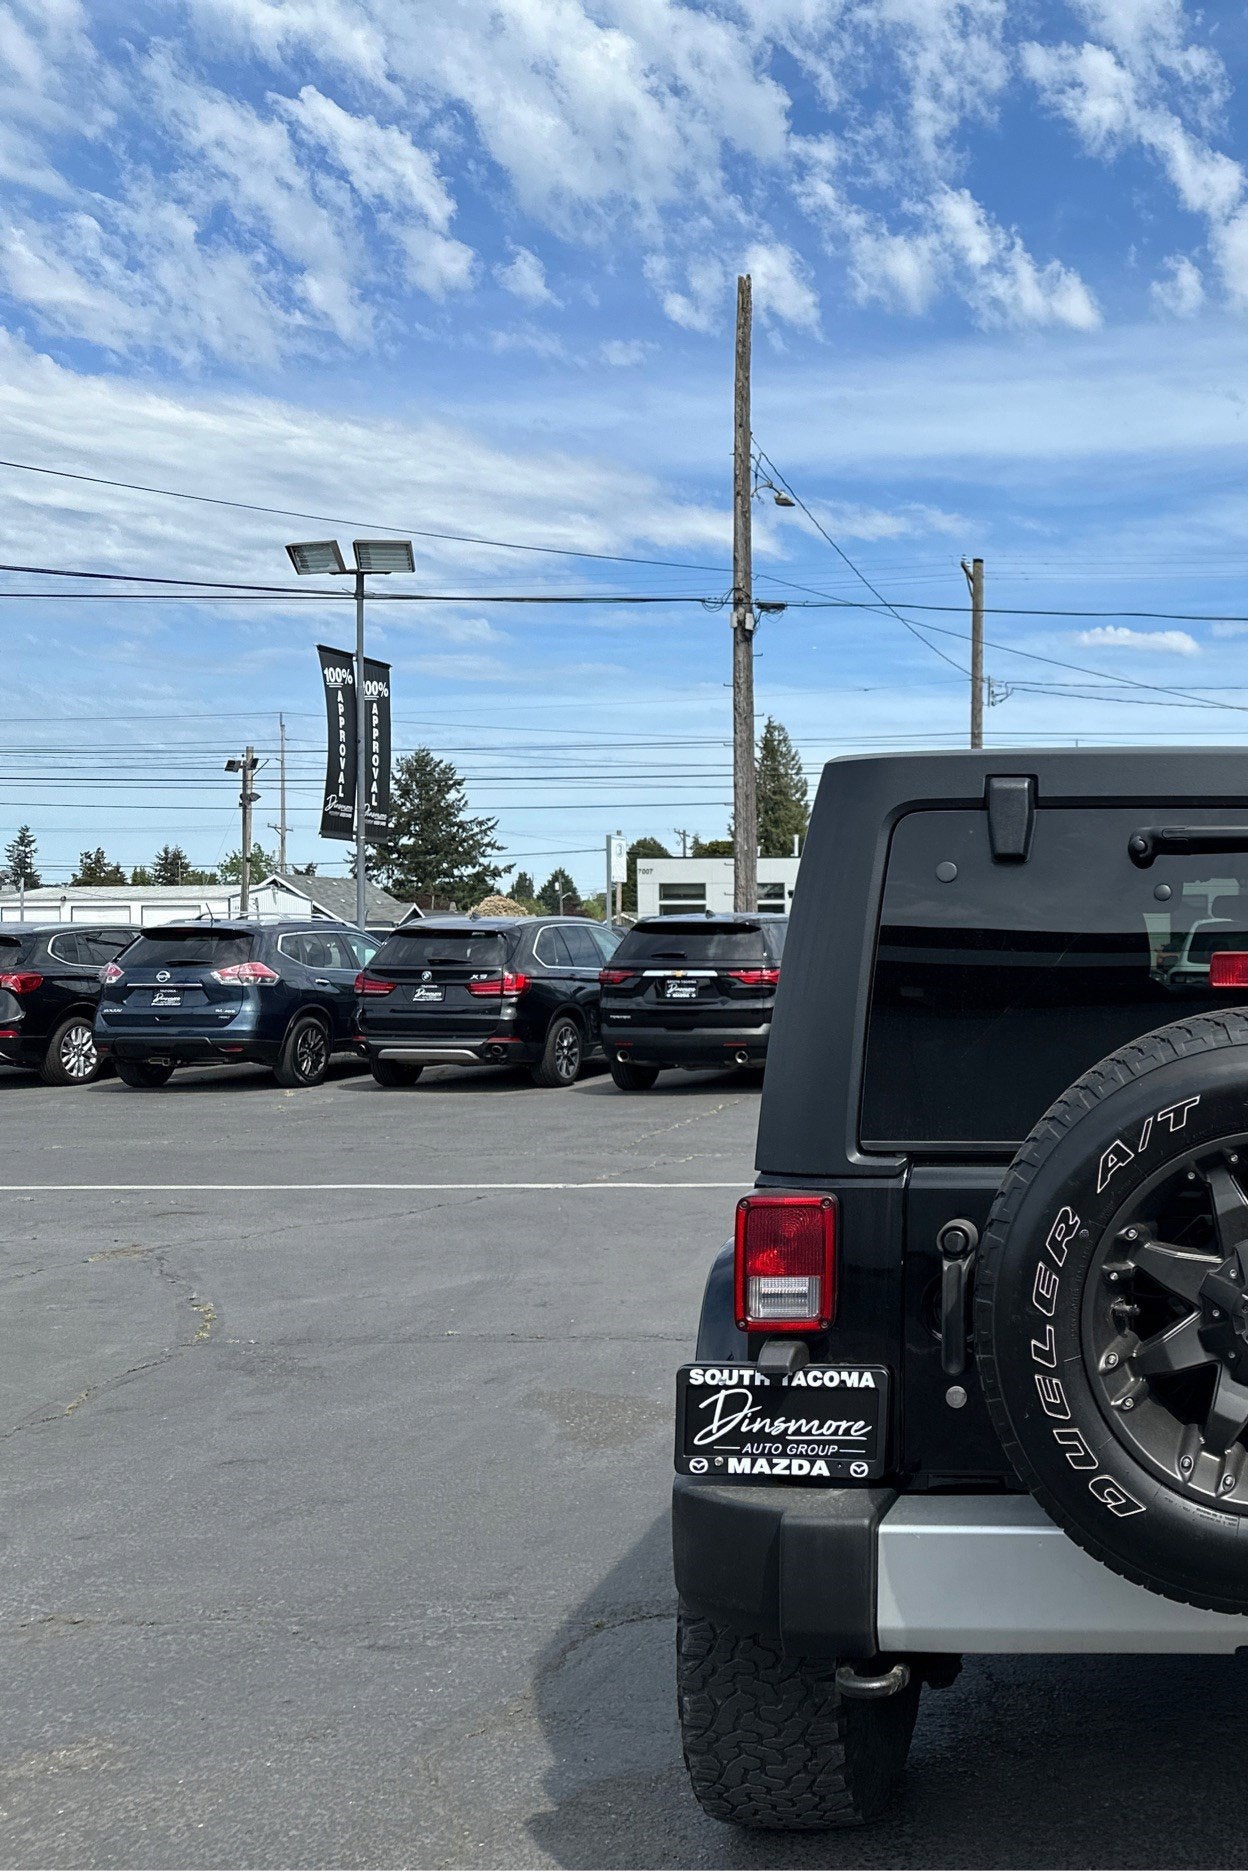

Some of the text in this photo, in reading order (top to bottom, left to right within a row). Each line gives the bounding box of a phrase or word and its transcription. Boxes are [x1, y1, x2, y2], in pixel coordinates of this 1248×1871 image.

[323, 667, 352, 684] 100%
[337, 690, 346, 798] APPROVAL
[1029, 1095, 1202, 1518] DUELER A/T
[689, 1369, 770, 1386] SOUTH
[693, 1388, 872, 1446] Dinsmore
[742, 1443, 839, 1456] AUTO GROUP
[727, 1458, 830, 1476] MAZDA
